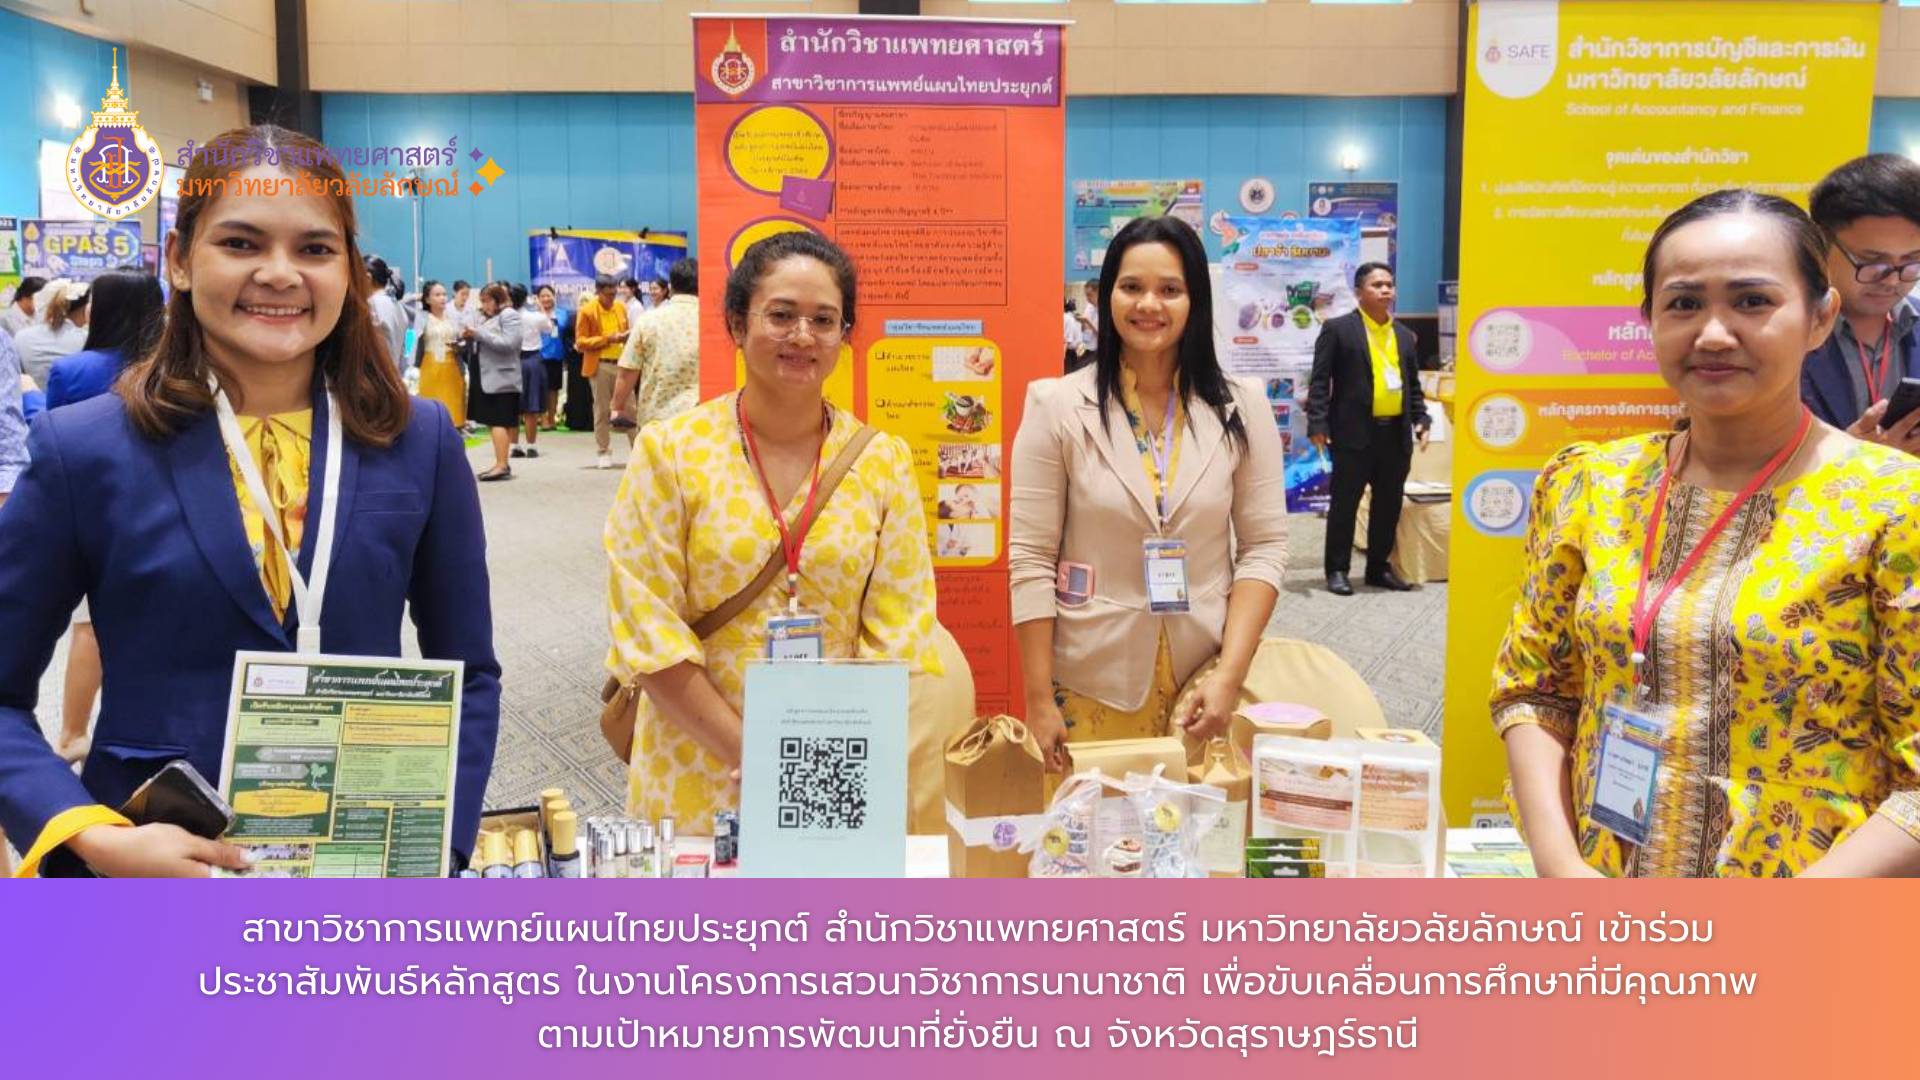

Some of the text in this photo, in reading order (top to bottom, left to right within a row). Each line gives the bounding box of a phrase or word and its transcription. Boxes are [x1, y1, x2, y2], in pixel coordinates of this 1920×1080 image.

[780, 28, 1045, 56] สำนักวิชาแพทยศาสตร์
[1507, 44, 1550, 59] SAFE
[1567, 35, 1867, 64] สำนักวิชาการบัญชีและการเงิน
[770, 74, 1053, 99] สาขาวิชาการแพทย์แผนไทยประยุกต์
[1566, 61, 1807, 91] มหาวิทยาลัยวลัยลักษณ์
[1566, 102, 1805, 118] School of Accountancy and Finance
[43, 234, 130, 256] GPAS 5
[1562, 348, 1618, 362] Bachelor
[1621, 349, 1634, 361] of
